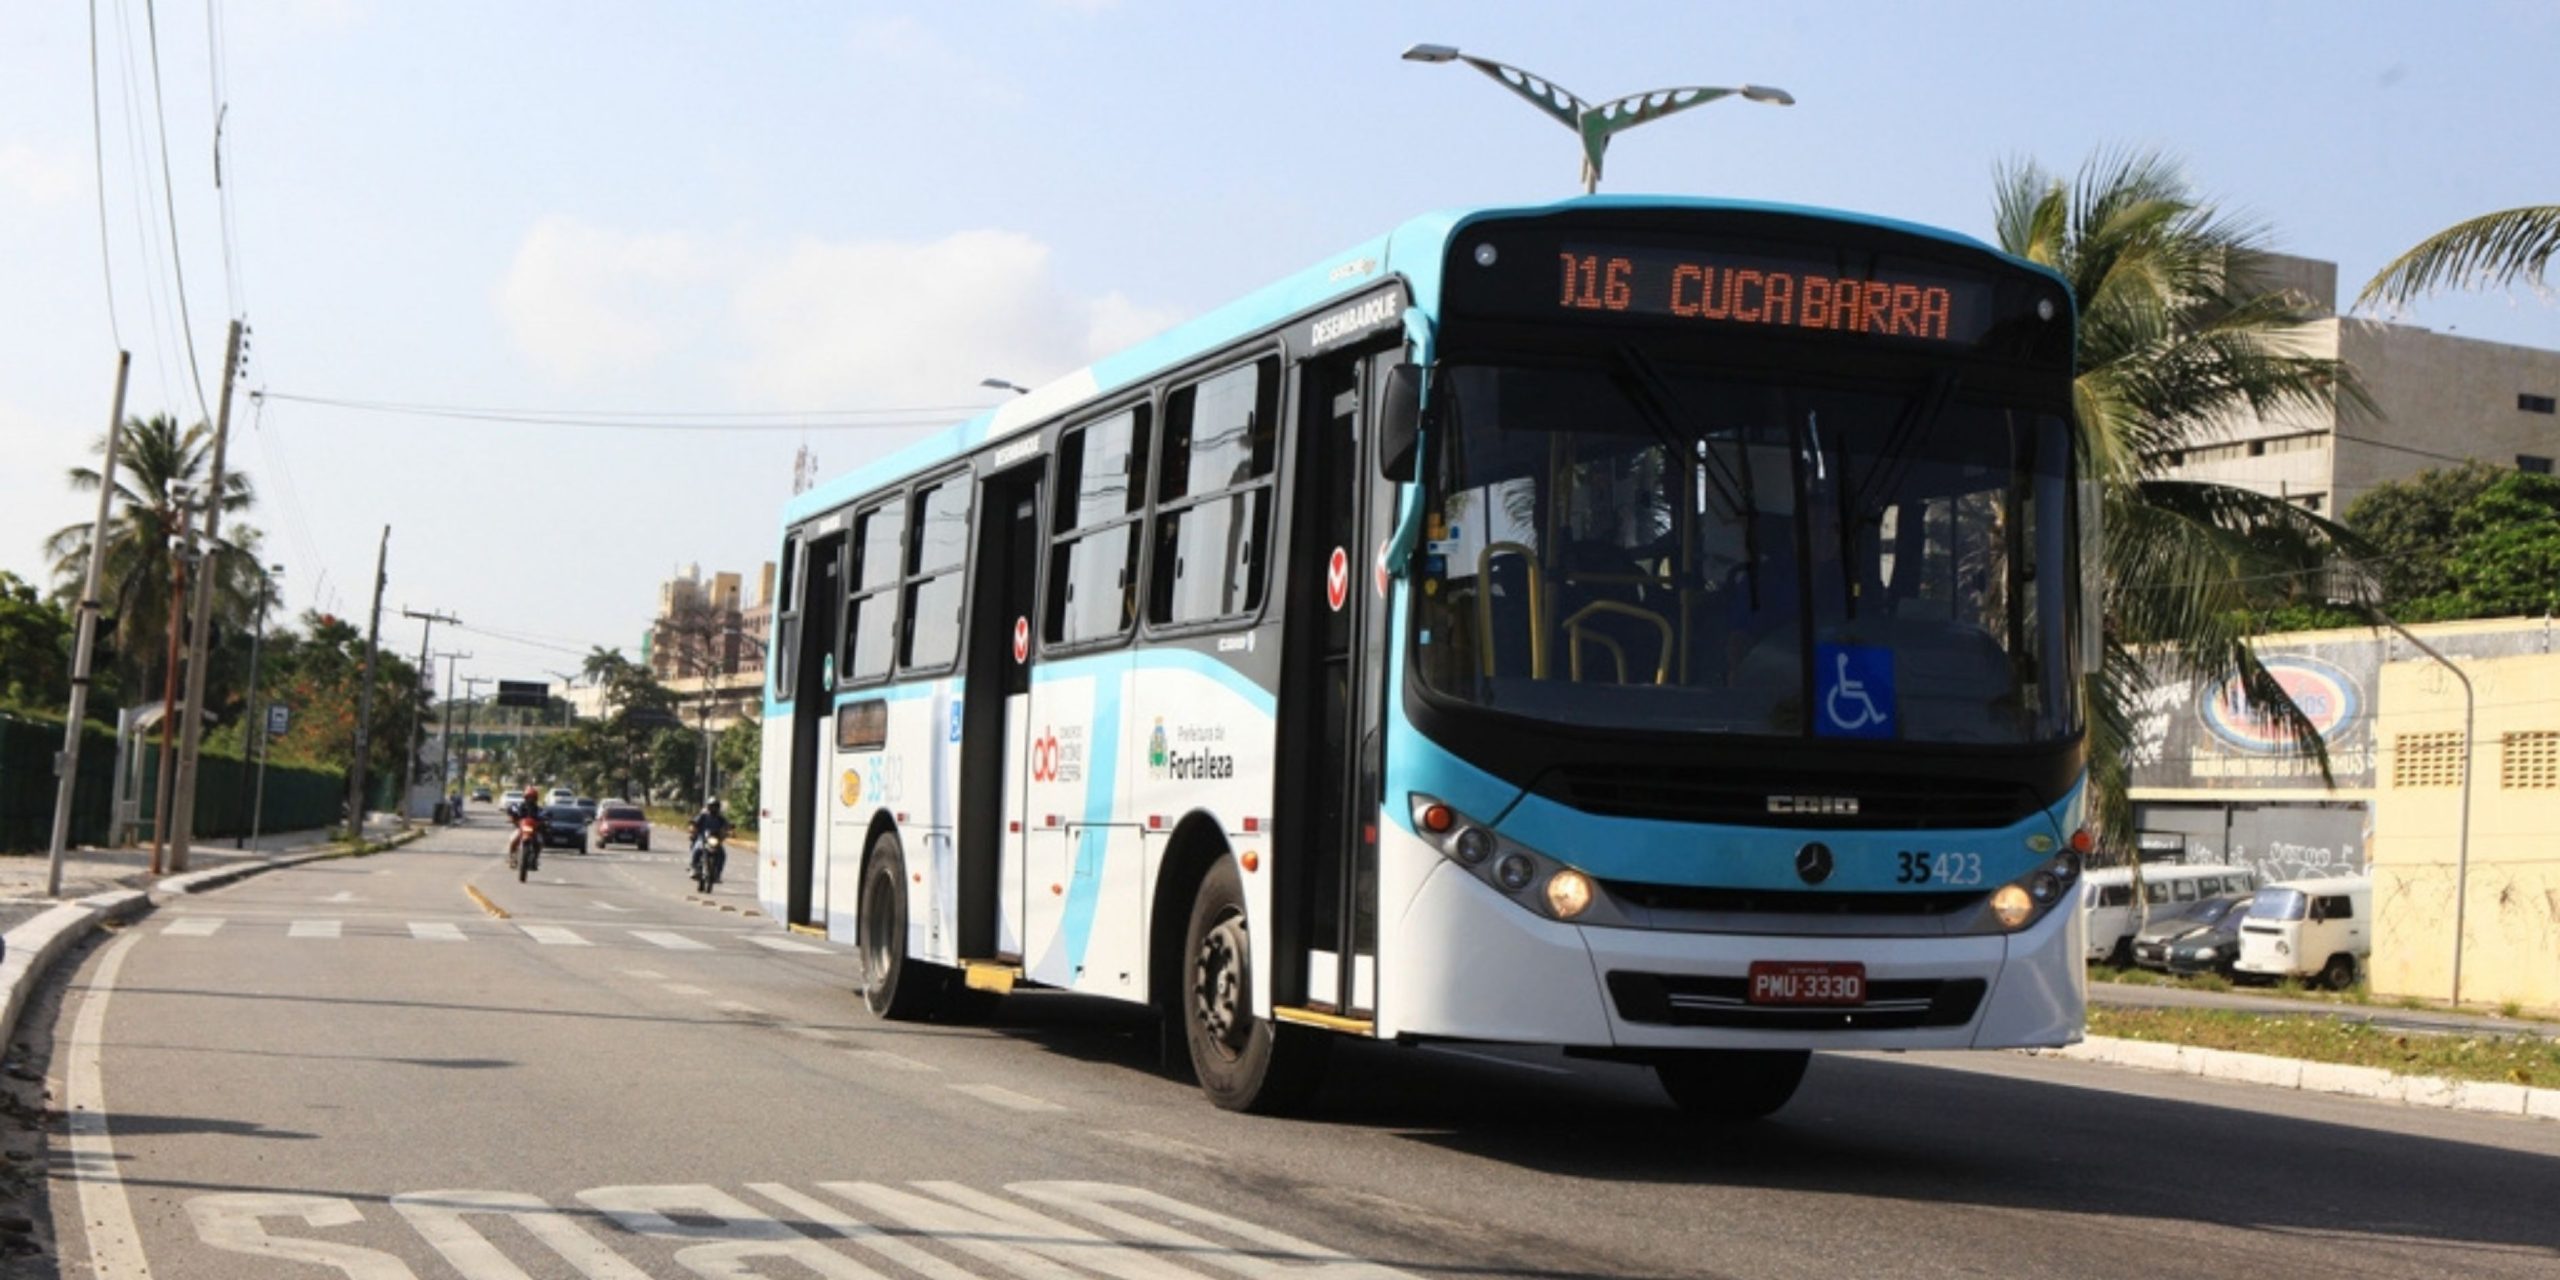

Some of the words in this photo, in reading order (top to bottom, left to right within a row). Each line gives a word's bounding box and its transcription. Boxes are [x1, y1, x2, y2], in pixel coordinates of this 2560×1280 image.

[1311, 291, 1397, 347] DESEMBARQUE
[1670, 264, 1793, 325] CUCA
[1800, 275, 1950, 339] BARRA
[1169, 746, 1233, 780] Fortaleza
[1766, 794, 1860, 816] CAIO
[1895, 851, 1982, 886] 35423
